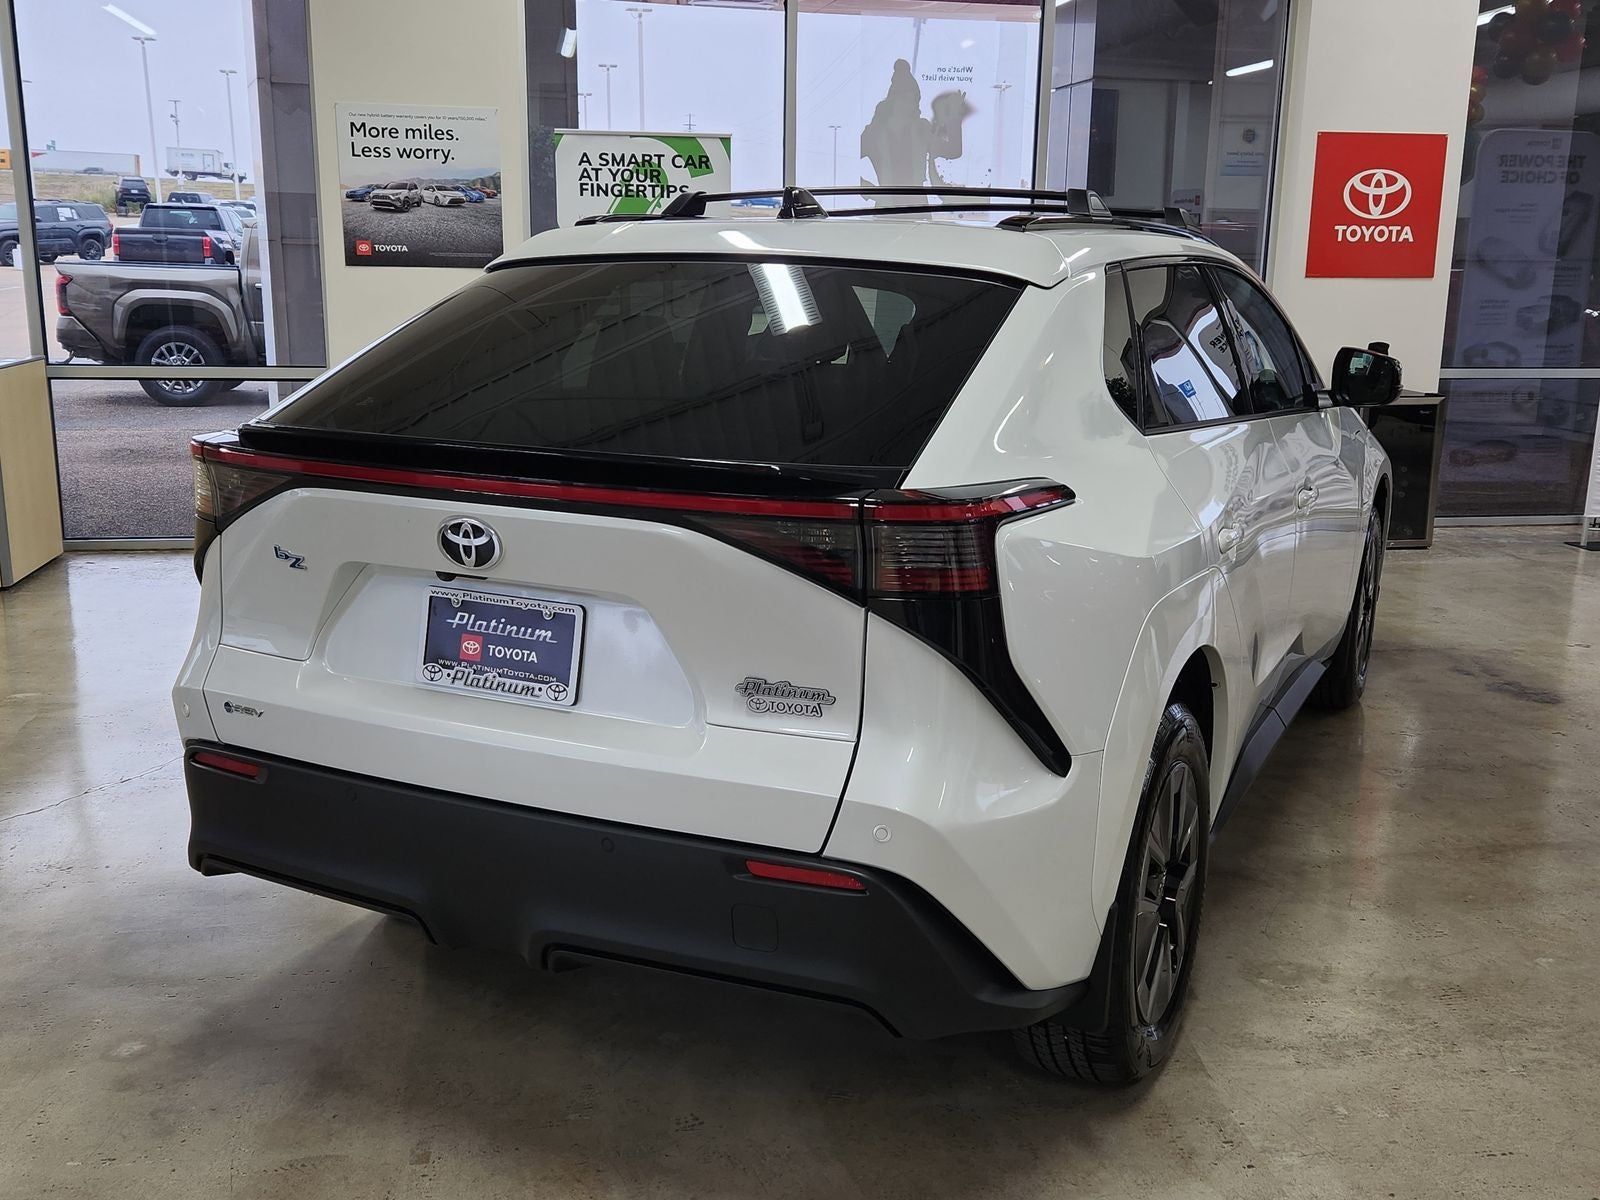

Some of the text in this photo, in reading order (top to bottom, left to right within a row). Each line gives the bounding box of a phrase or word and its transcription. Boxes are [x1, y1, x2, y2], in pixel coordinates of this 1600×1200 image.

[350, 122, 459, 141] More miles.
[351, 142, 455, 164] Less worry.
[578, 152, 710, 169] A SMART CAR
[578, 168, 661, 183] AT YOUR
[1335, 225, 1414, 242] TOYOTA
[374, 244, 408, 252] TOYOTA
[431, 589, 575, 613] www.PlatinumToyota.com
[446, 612, 557, 643] Platinum
[488, 644, 538, 663] TOYOTA
[451, 667, 542, 697] Platinum
[734, 680, 834, 704] Platinum
[768, 701, 820, 716] TOYOTA
